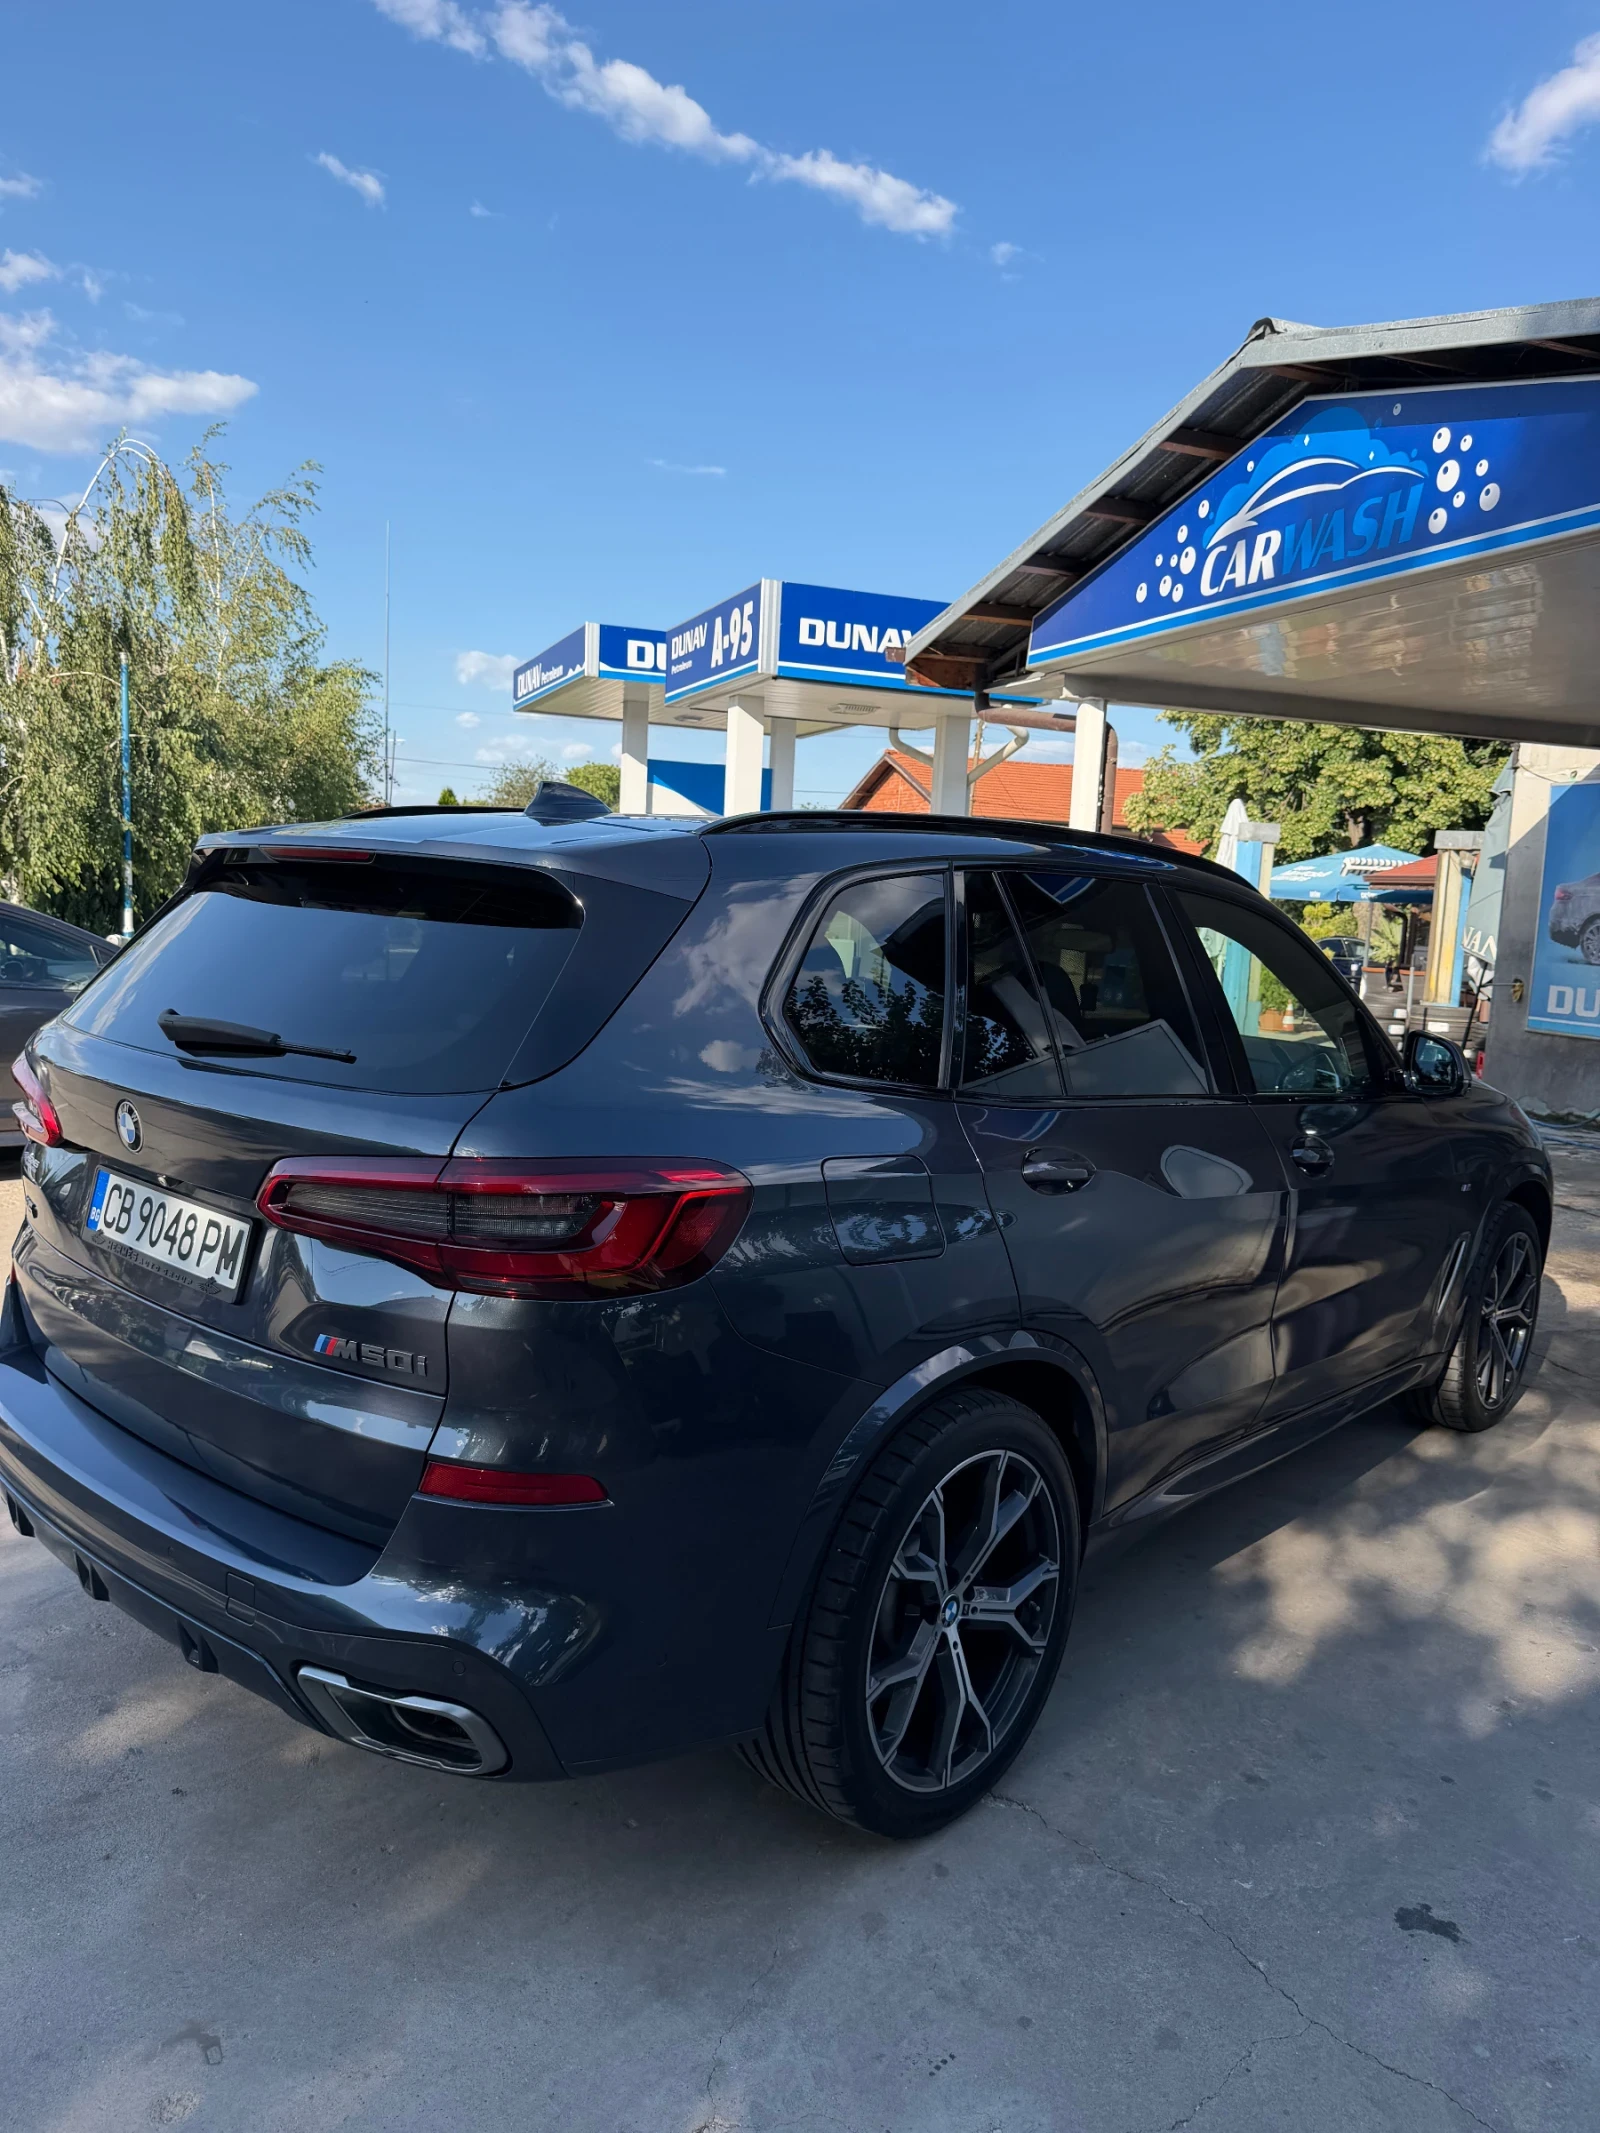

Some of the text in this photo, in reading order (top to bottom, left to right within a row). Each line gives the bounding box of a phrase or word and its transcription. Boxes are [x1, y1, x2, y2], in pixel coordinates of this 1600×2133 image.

[671, 622, 708, 660] DUNAV
[711, 600, 753, 669] A-95
[799, 617, 914, 653] DUNA
[517, 662, 542, 698] DUNAV
[1546, 984, 1600, 1018] DU
[90, 1206, 100, 1221] BG
[104, 1183, 245, 1280] CB 9048 PM
